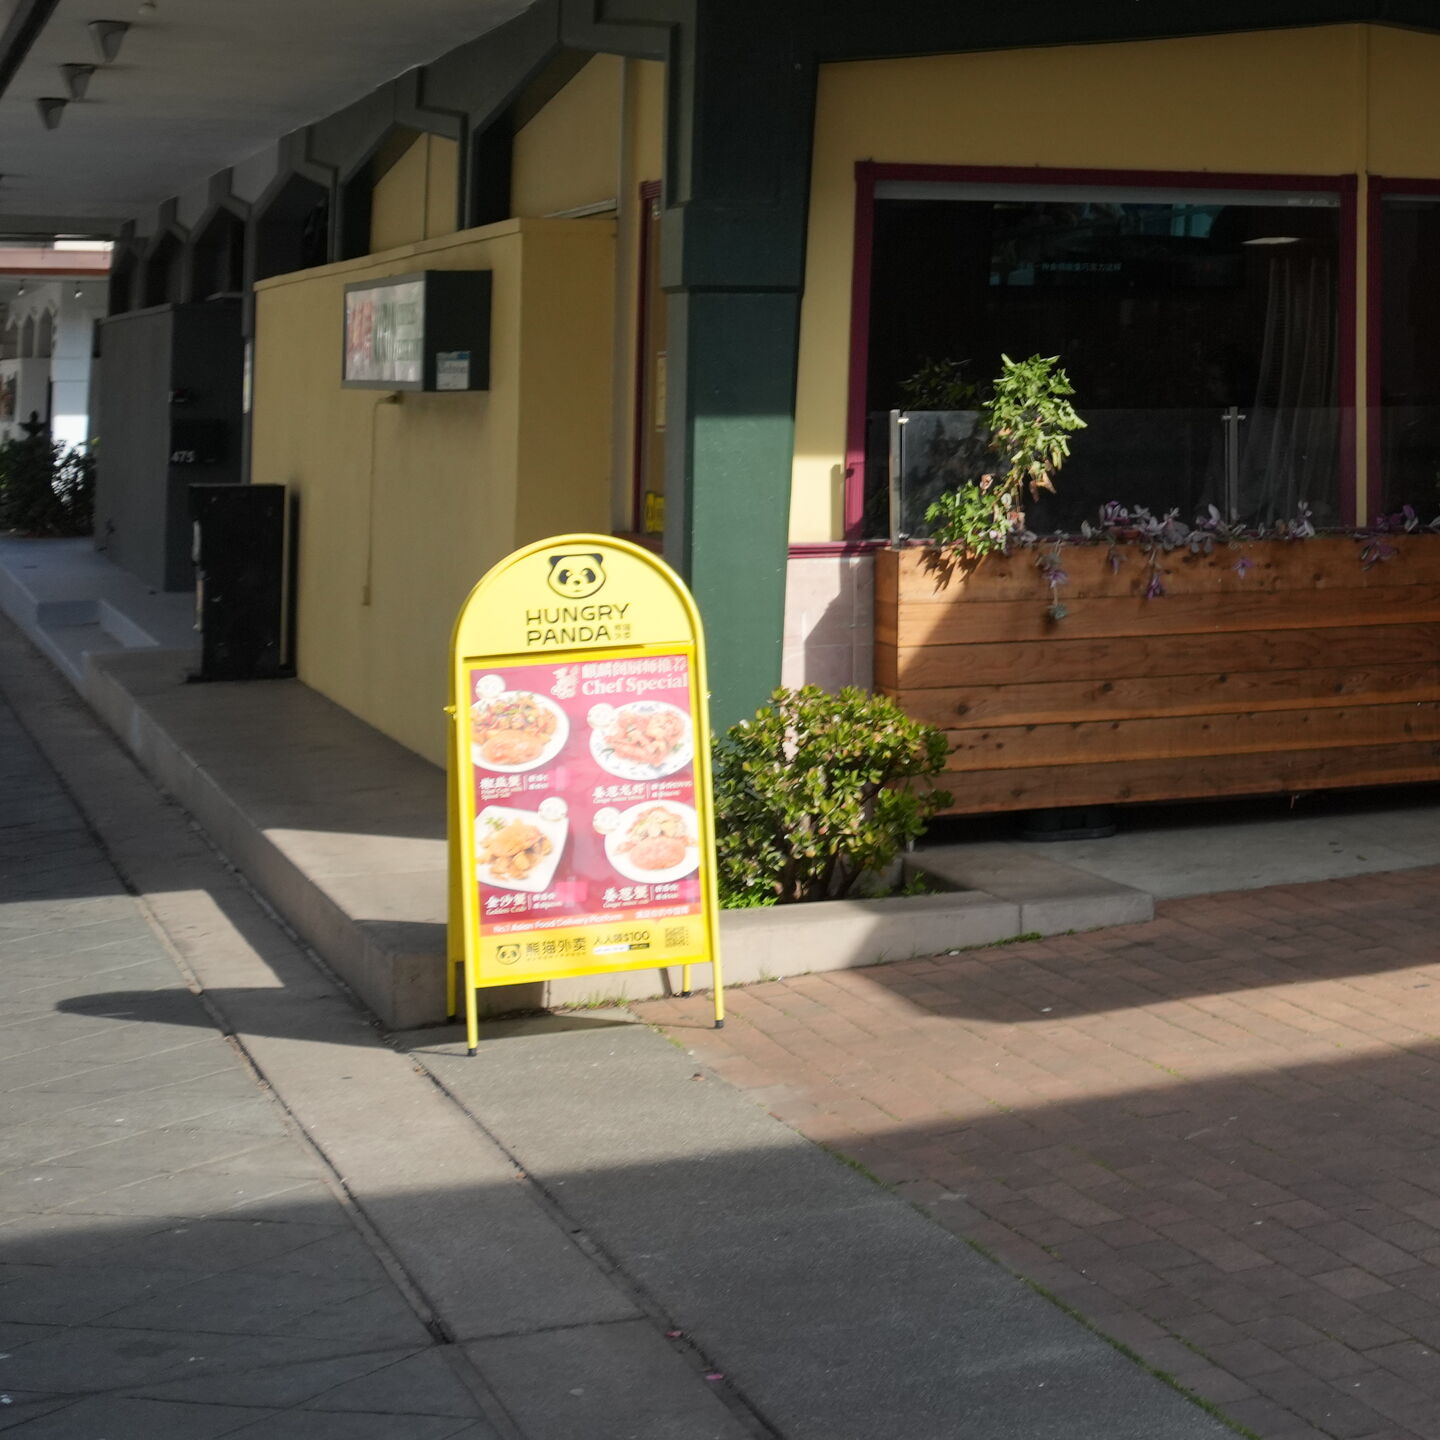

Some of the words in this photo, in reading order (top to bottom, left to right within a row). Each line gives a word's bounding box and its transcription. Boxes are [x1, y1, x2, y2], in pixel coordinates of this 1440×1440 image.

[526, 603, 630, 626] HUNGRY
[527, 625, 611, 646] PANDA
[582, 677, 623, 695] Chef
[626, 673, 688, 695] Special
[526, 937, 586, 954] 熊猫外卖
